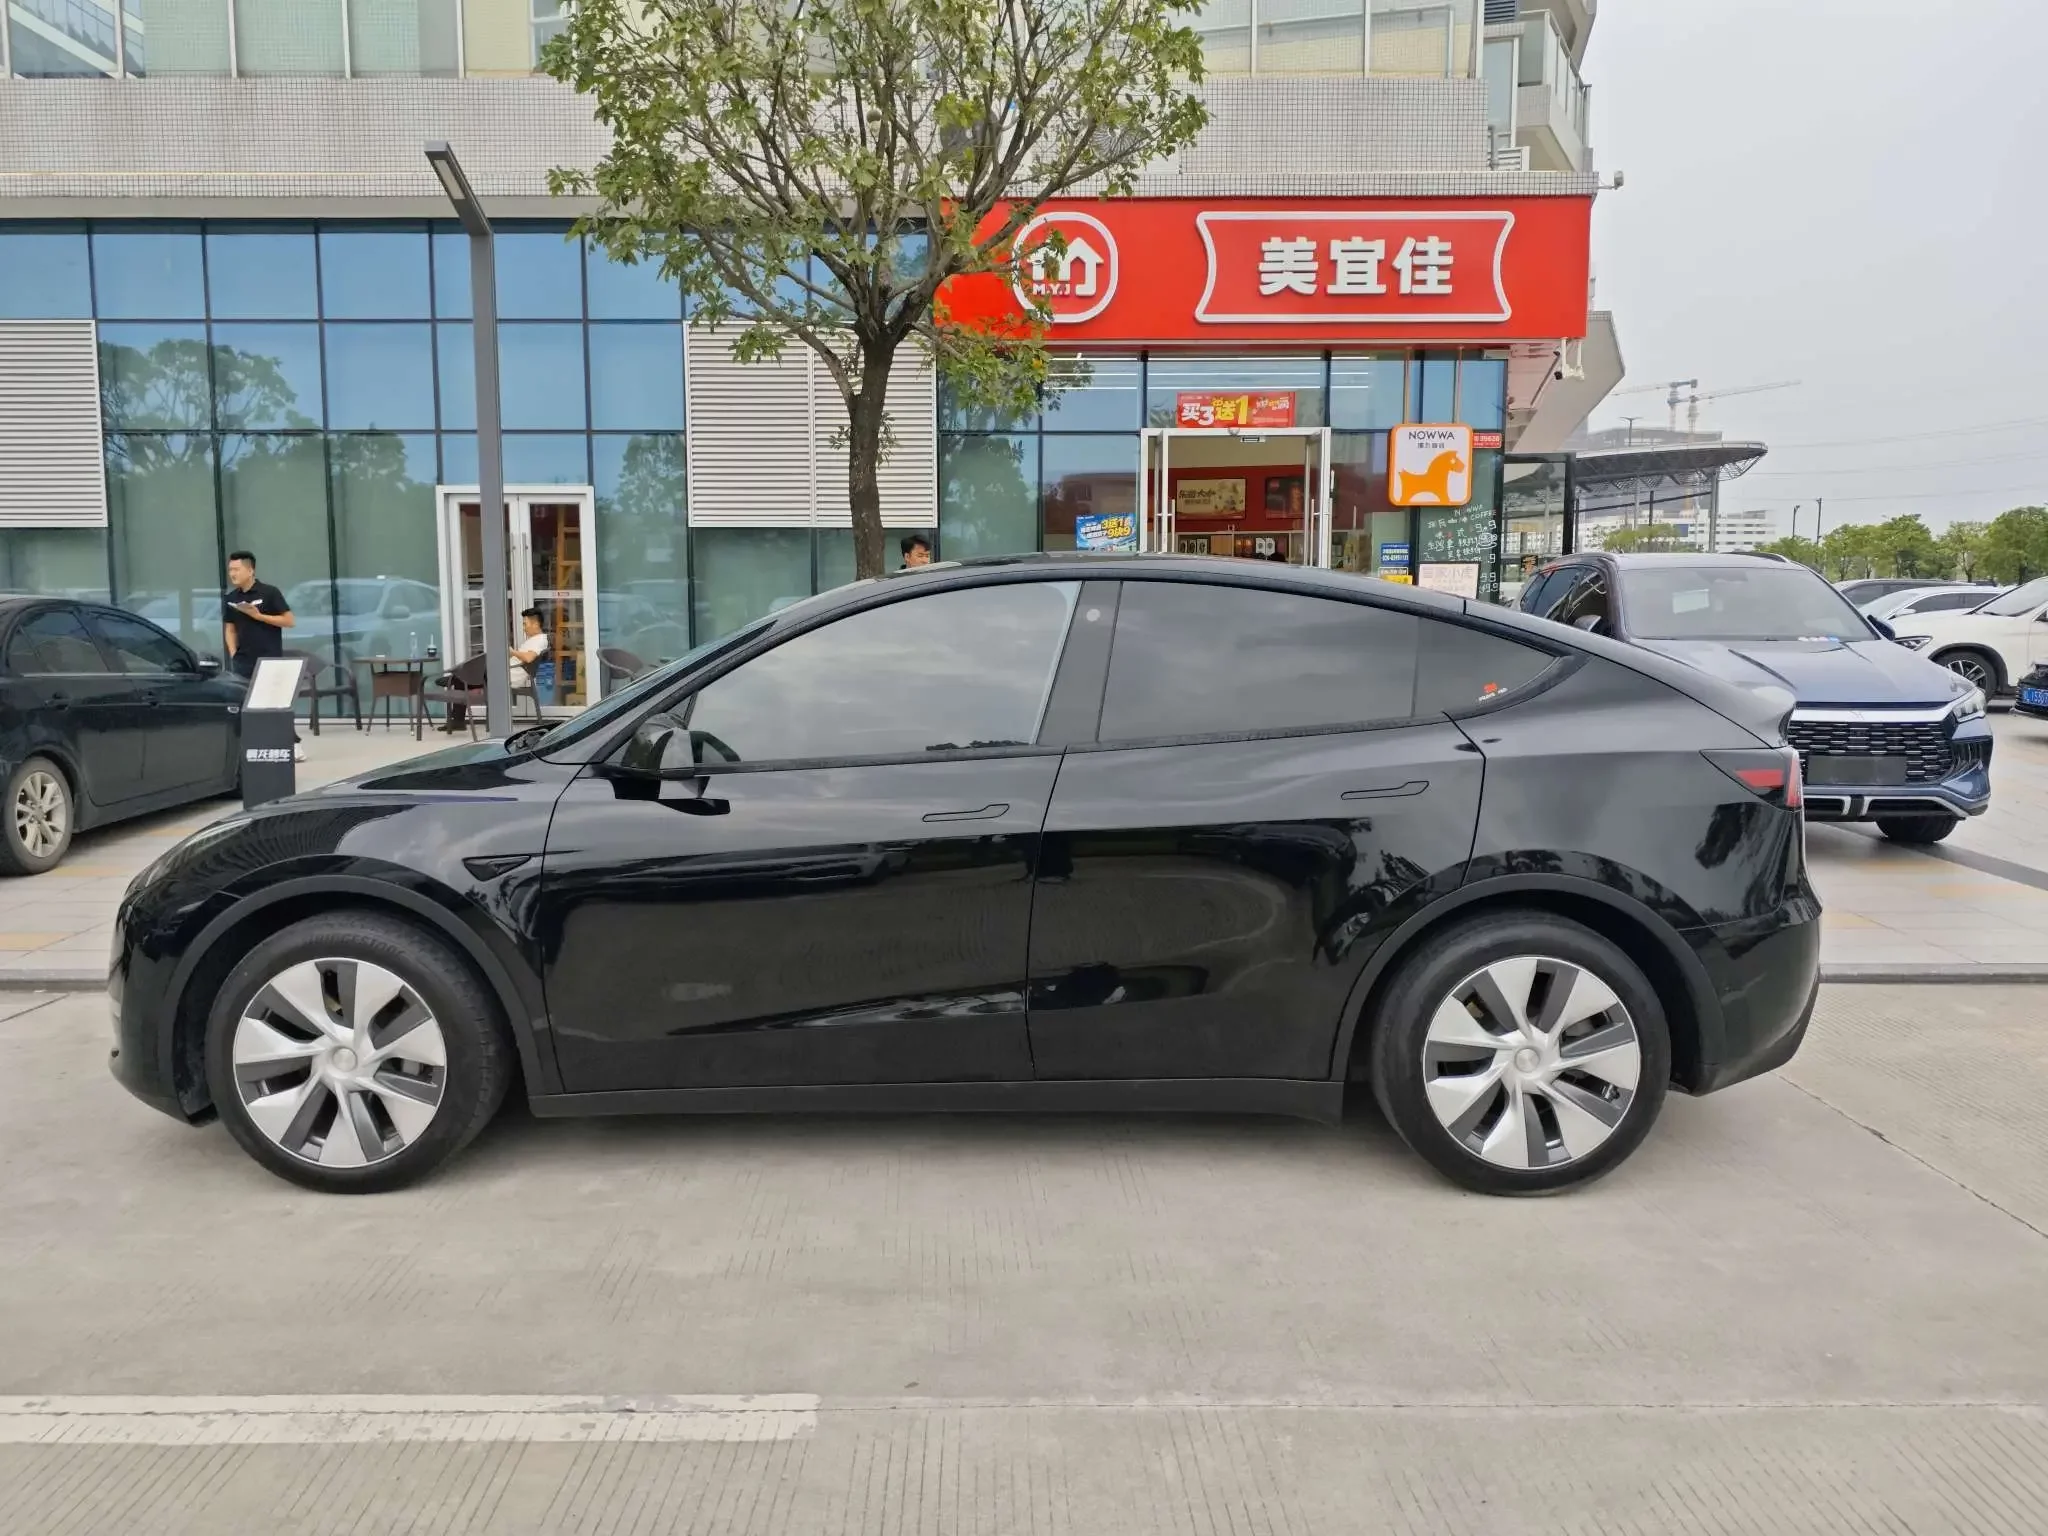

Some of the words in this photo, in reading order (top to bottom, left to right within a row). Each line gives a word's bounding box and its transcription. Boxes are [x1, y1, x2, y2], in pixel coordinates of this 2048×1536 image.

[1258, 236, 1454, 295] 美宜佳
[1408, 430, 1455, 440] NOWWA
